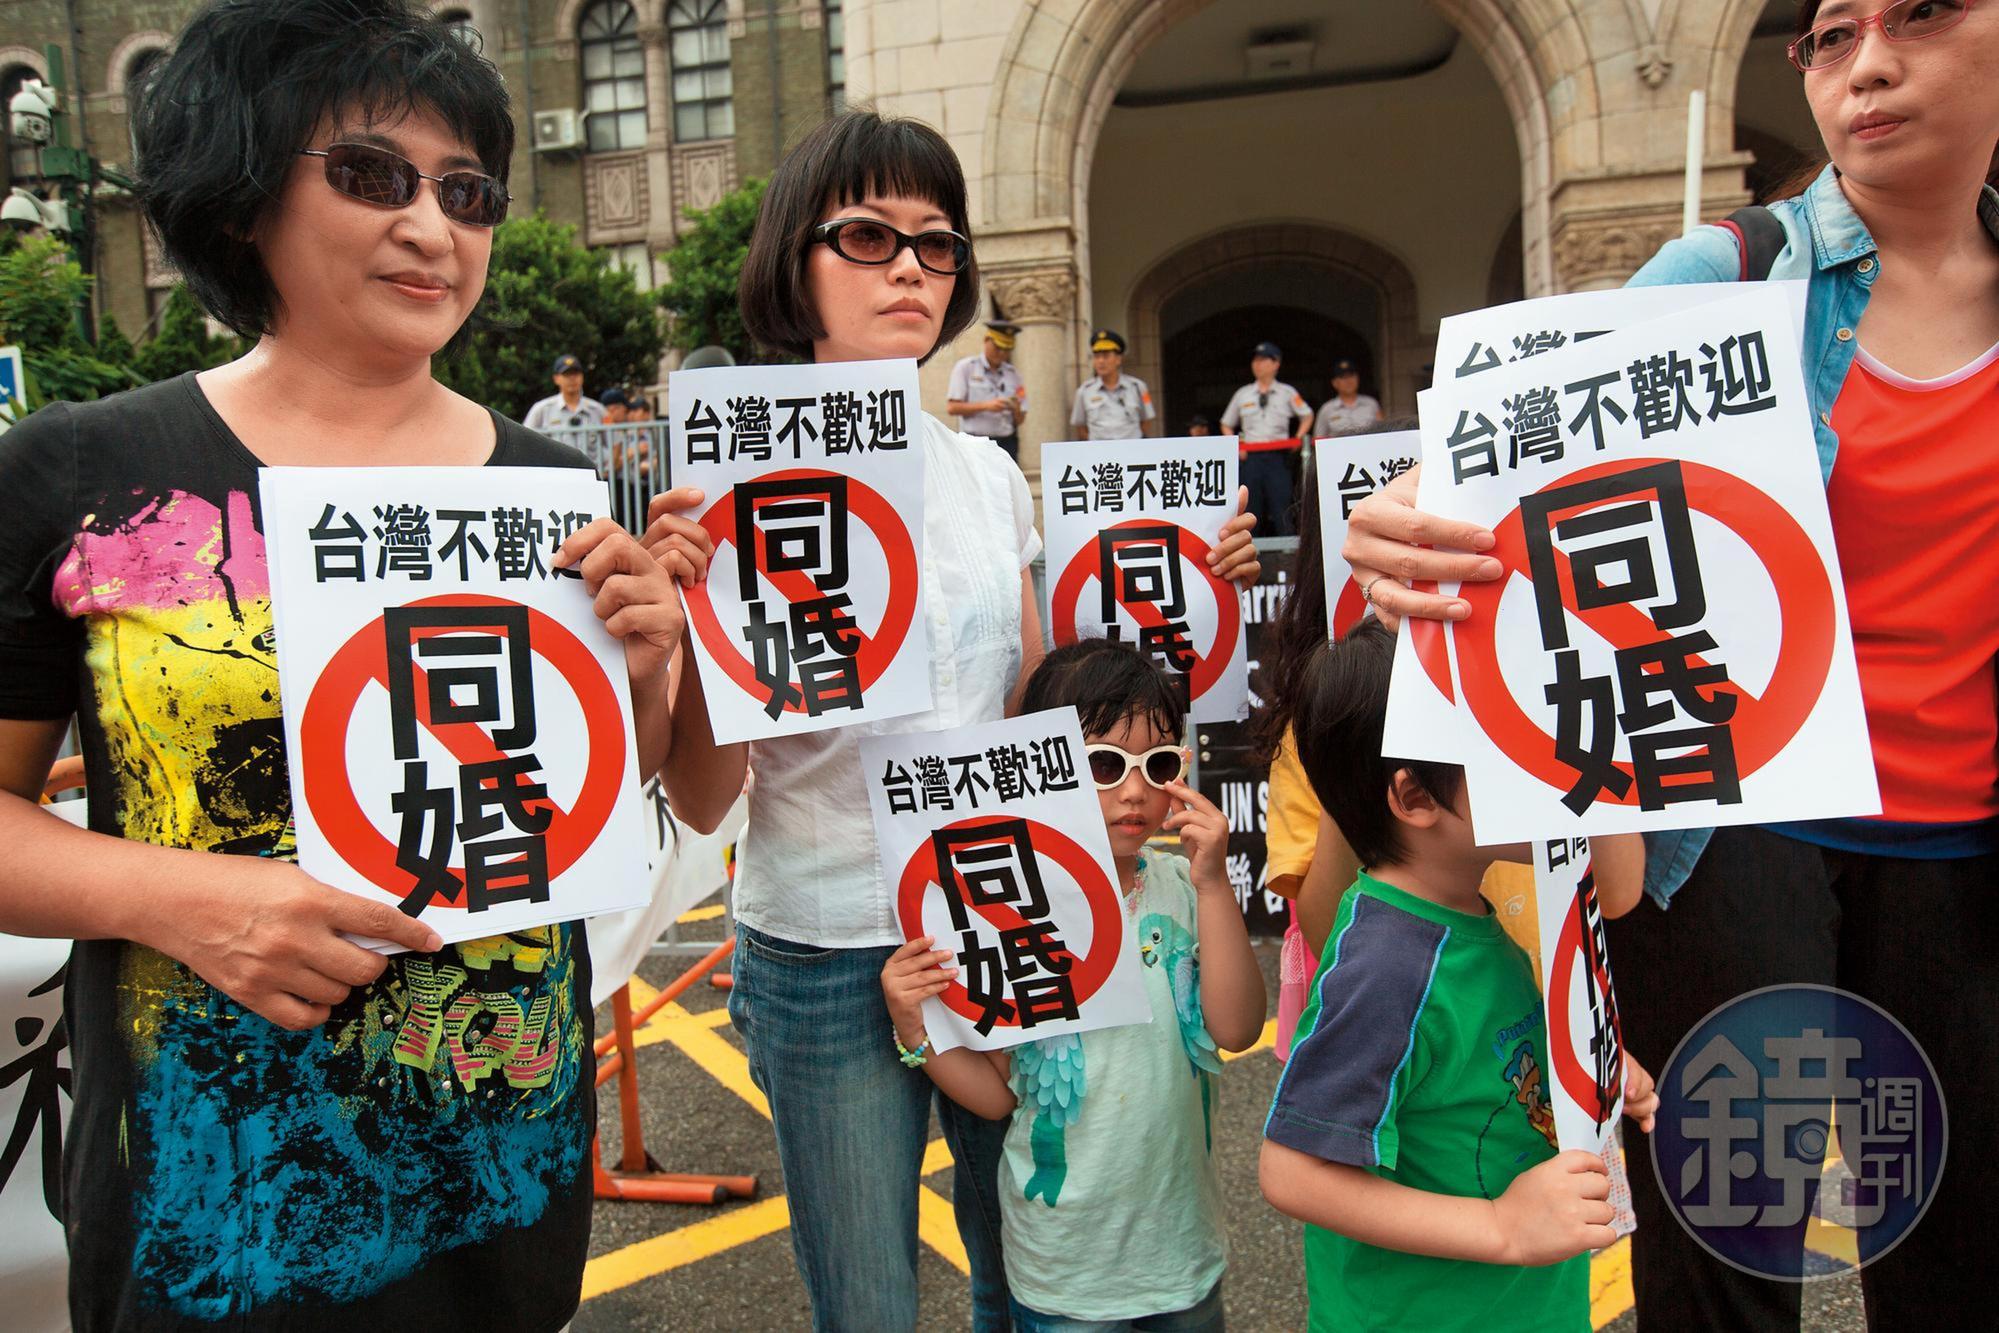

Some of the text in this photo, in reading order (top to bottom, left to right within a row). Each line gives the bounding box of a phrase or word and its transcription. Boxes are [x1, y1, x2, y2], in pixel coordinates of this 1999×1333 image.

[684, 389, 908, 465] 台灣不歡迎
[1057, 458, 1227, 515] 台灣不歡迎
[1446, 330, 1777, 486] 台灣不歡迎
[734, 475, 865, 722] 同婚
[1519, 459, 1743, 817] 同婚
[384, 605, 553, 918] 同婚
[881, 735, 1080, 815] 台灣不歡迎
[931, 818, 1081, 1038] 同婚
